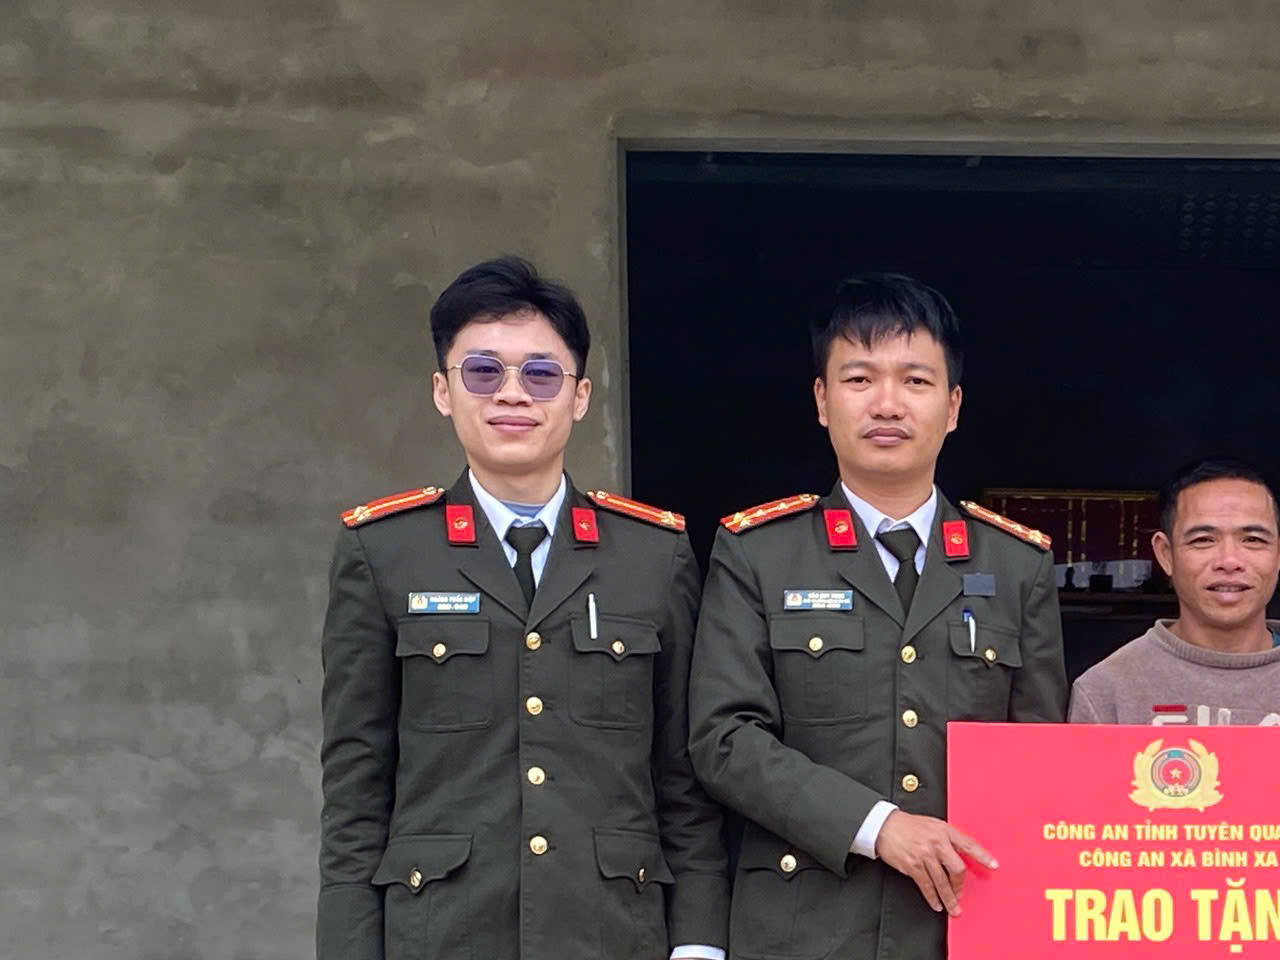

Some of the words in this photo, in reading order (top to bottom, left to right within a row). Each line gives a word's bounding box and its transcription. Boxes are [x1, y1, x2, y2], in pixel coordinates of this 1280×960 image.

[1042, 820, 1097, 842] CÔNG
[1101, 823, 1129, 841] AN
[1135, 819, 1179, 841] TỈNH
[1183, 821, 1244, 841] TUYÊN
[1079, 846, 1133, 868] CÔNG
[1137, 850, 1165, 868] AN
[1170, 848, 1197, 868] XÃ
[1201, 846, 1249, 868] BÌNH
[1253, 850, 1279, 868] XA
[1045, 888, 1174, 942] TRAO
